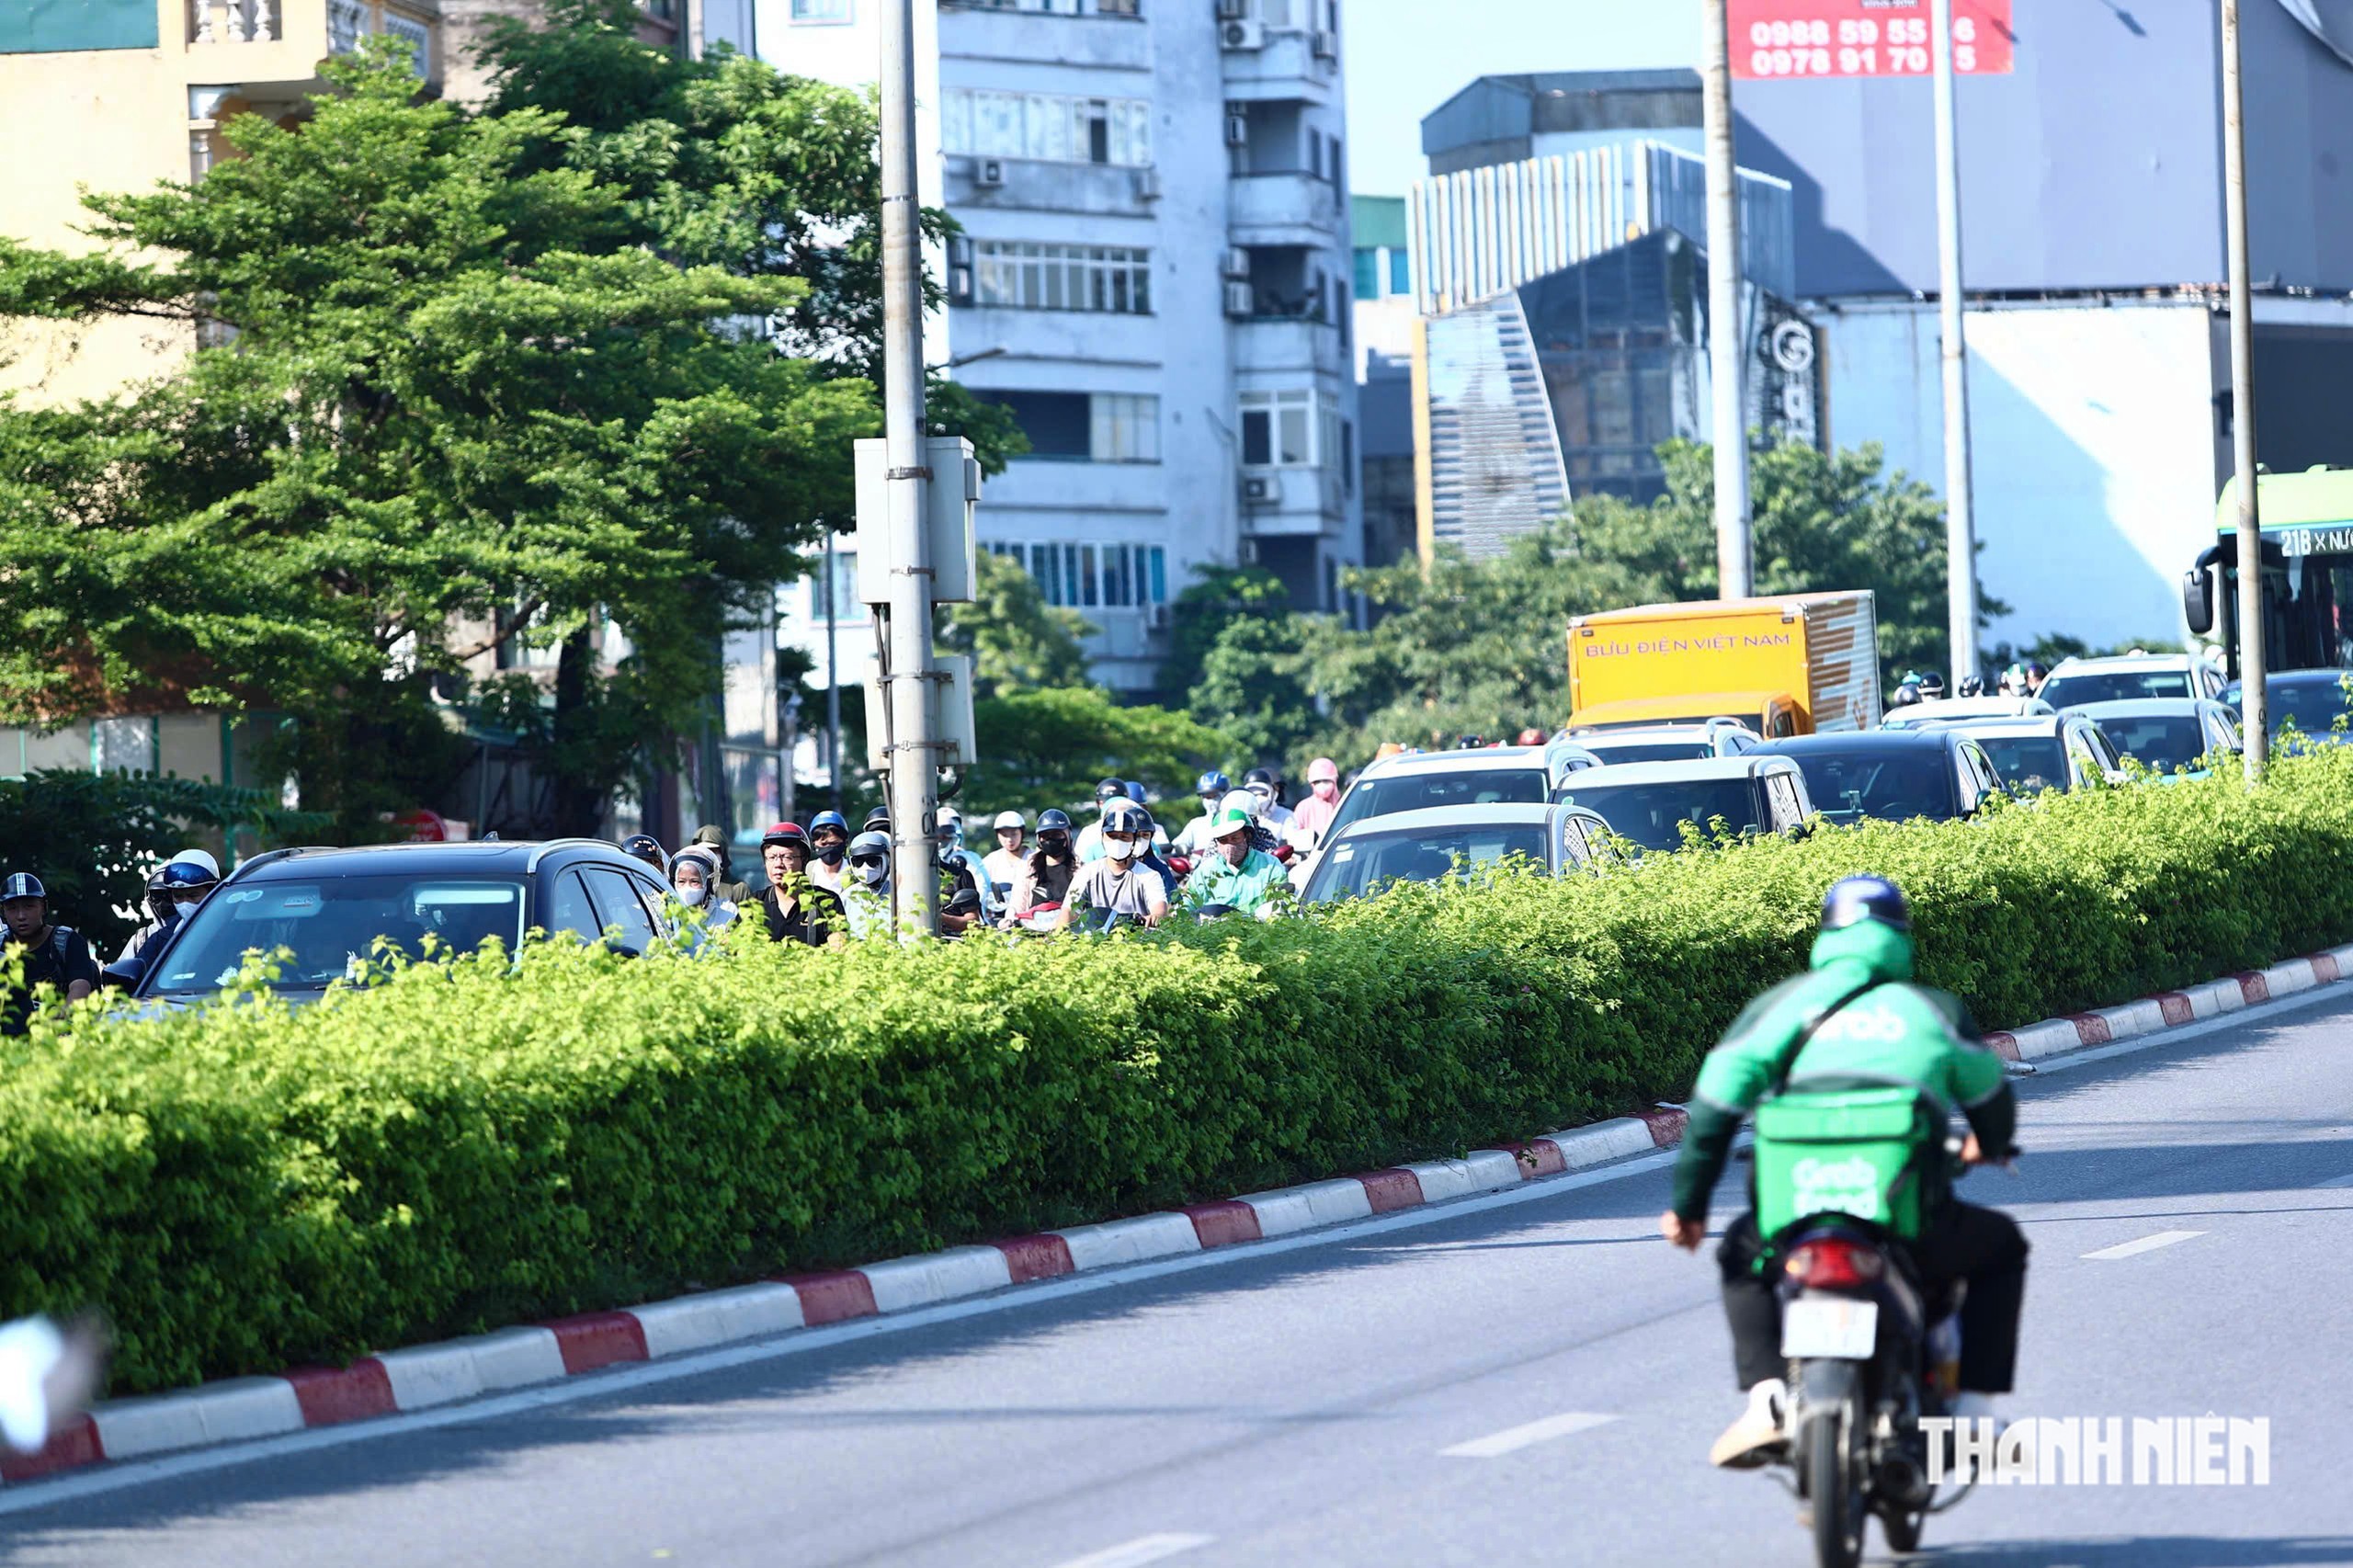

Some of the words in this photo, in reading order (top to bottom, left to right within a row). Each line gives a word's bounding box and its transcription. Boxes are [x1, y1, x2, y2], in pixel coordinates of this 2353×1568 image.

[1953, 17, 1975, 43] 6
[1955, 46, 1976, 72] 5
[1586, 642, 1629, 657] BƯU
[1638, 636, 1688, 655] ĐIỆN
[1694, 632, 1736, 653] VIỆT
[1744, 633, 1790, 647] NAM
[1792, 1156, 1877, 1187] Grab
